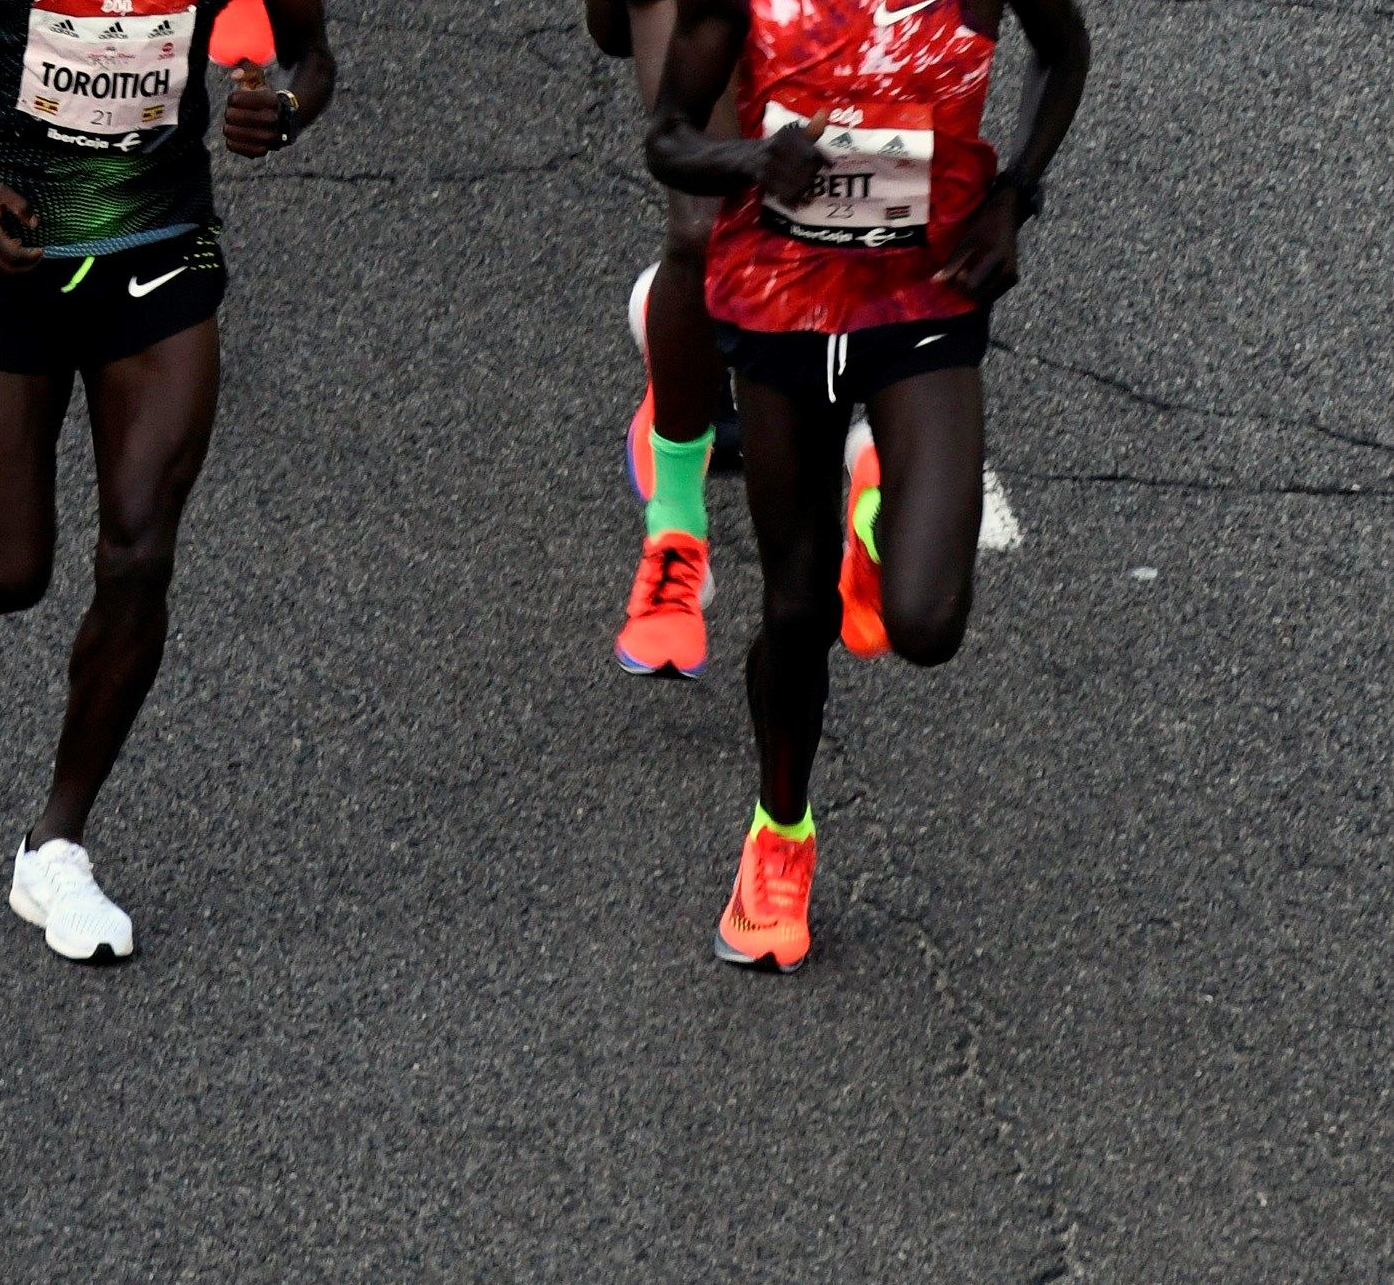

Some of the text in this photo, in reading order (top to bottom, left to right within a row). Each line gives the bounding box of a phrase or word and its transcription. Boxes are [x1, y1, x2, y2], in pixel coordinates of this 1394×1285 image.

[41, 61, 171, 100] TOROITICH
[90, 109, 114, 126] 21
[808, 173, 876, 199] BETT
[825, 202, 855, 219] 23
